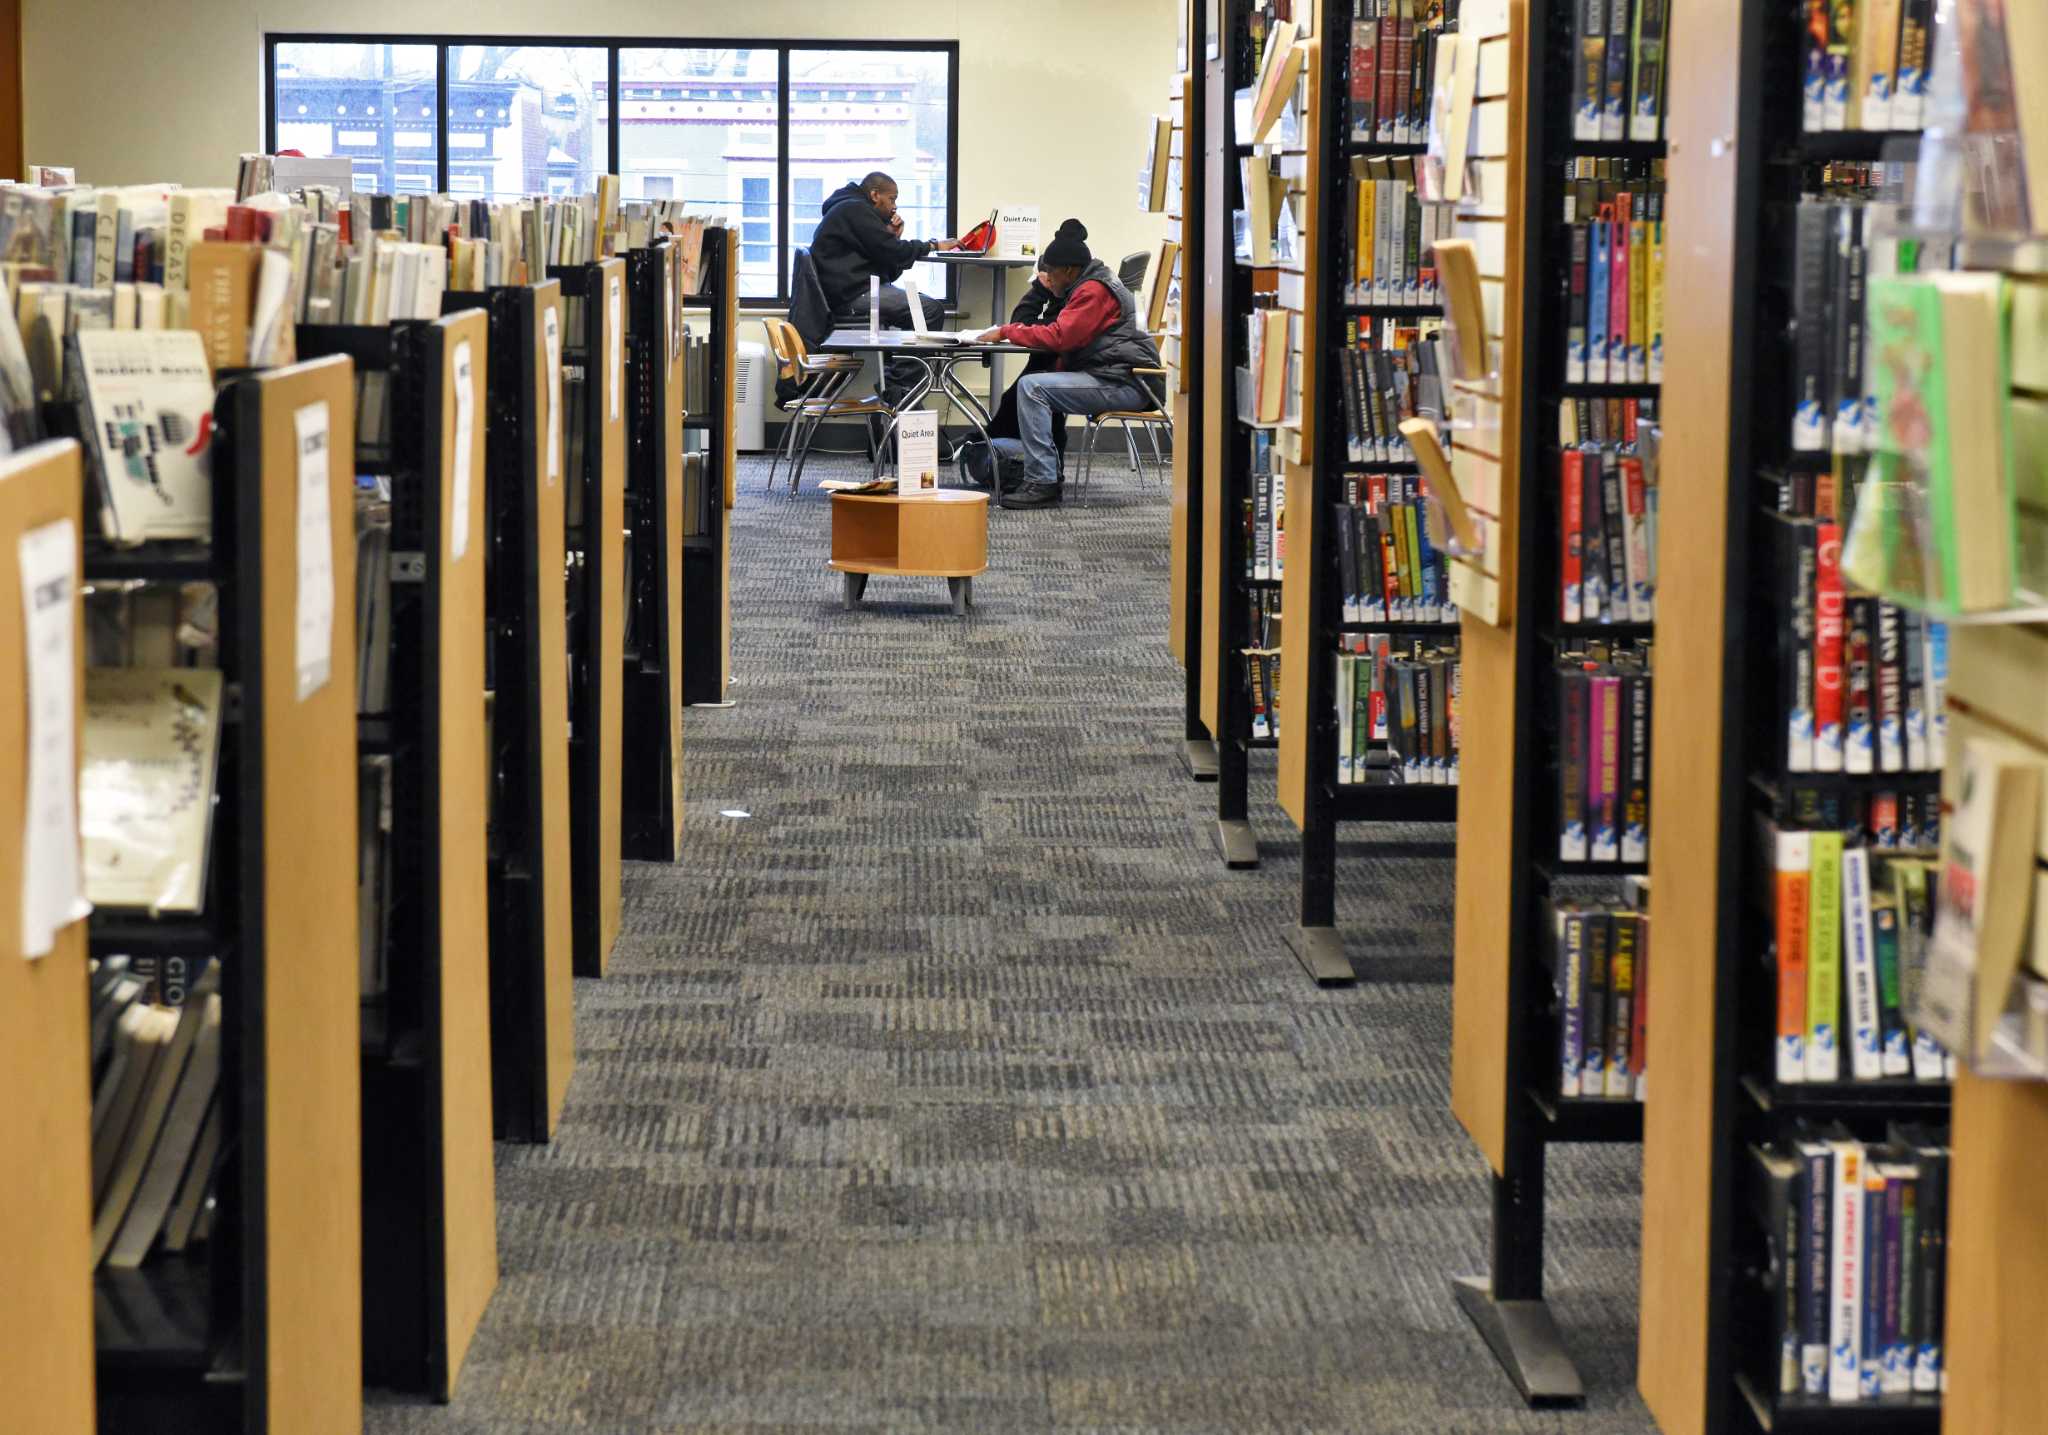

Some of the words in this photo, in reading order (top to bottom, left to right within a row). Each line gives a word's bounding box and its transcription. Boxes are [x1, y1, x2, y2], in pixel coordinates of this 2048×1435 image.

[1003, 215, 1021, 223] Quiet
[170, 212, 187, 282] DEGAS
[901, 430, 920, 440] Quiet
[920, 430, 935, 439] Area
[1258, 477, 1268, 494] TED
[1258, 496, 1268, 518] BELL
[1633, 688, 1646, 717] DEAD
[1633, 719, 1646, 753] MAN'S
[1633, 755, 1646, 782] TIME
[1567, 920, 1583, 949] EXIT
